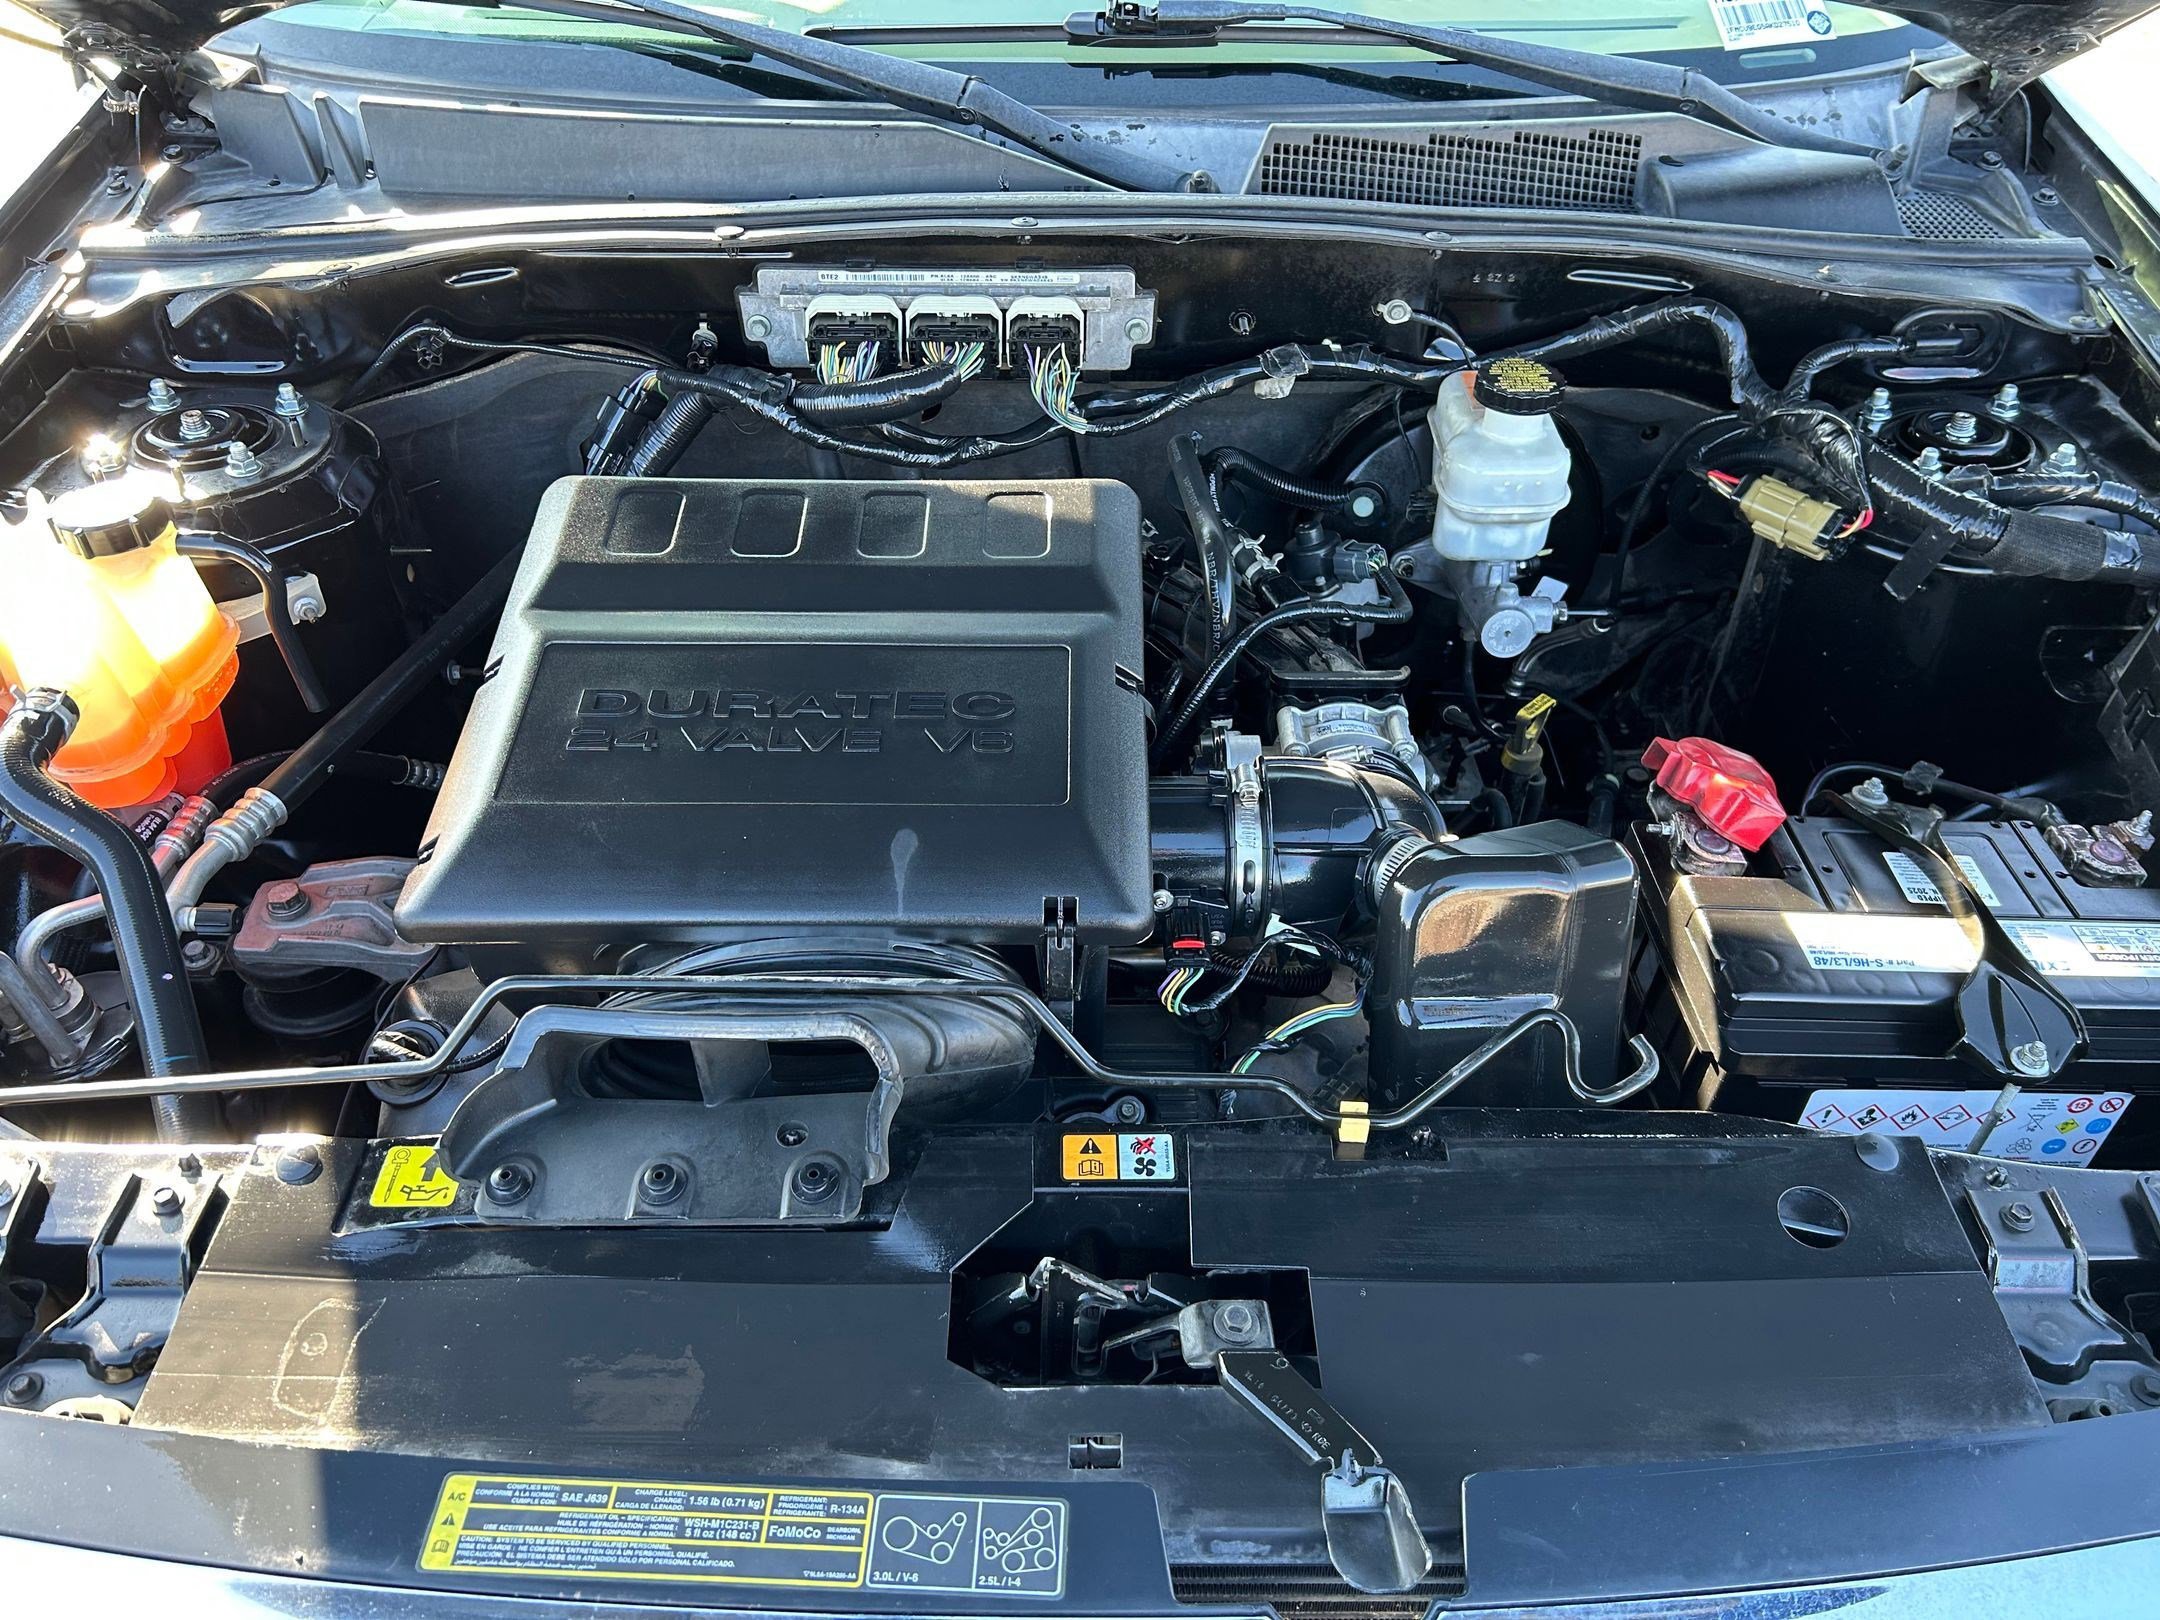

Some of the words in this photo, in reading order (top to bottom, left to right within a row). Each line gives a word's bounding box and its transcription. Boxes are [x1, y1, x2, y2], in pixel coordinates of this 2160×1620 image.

[576, 688, 1016, 720] DURATEC
[565, 726, 659, 752] 24
[680, 726, 883, 753] VALVE
[923, 727, 1015, 754] V6
[1917, 894, 1942, 902] IPPED
[1813, 956, 1884, 968] S-H6/L3/48
[1895, 959, 1915, 967] Part
[475, 1488, 513, 1497] CONFORME
[530, 1490, 555, 1498] NORME
[507, 1483, 541, 1491] COMPLIES
[635, 1488, 664, 1497] CHARGE
[448, 1492, 467, 1501] A/C
[511, 1497, 539, 1505] CUMPLE
[561, 1492, 583, 1503] SAE
[584, 1493, 609, 1504] J639
[654, 1496, 683, 1504] CHARGE
[779, 1495, 828, 1504] REFRIGERANT:
[651, 1503, 685, 1511] LLENADO:
[689, 1496, 709, 1506] 1.56
[710, 1497, 720, 1506] lb
[721, 1497, 746, 1508] (0.71
[748, 1498, 766, 1510] kg)
[773, 1508, 826, 1517] REFRIGERANTE:
[830, 1504, 865, 1515] R-134A
[557, 1519, 578, 1527] HUILE
[559, 1511, 607, 1520] REFRIGERANT
[608, 1513, 619, 1521] OIL
[627, 1515, 680, 1523] SPECIFICATION:
[684, 1518, 760, 1530] WSH-M1C231-B
[483, 1523, 498, 1531] USE
[498, 1524, 524, 1532] ACEITE
[525, 1525, 544, 1533] PARA
[544, 1526, 601, 1535] REFRIGERANTES
[602, 1527, 641, 1536] CONFORME
[648, 1530, 676, 1538] NORMA:
[684, 1528, 692, 1537] 5
[693, 1528, 701, 1537] fl
[702, 1530, 715, 1538] oz
[716, 1529, 738, 1540] (148
[739, 1530, 757, 1540] cc)
[769, 1525, 822, 1539] FoMoCo
[496, 1536, 525, 1544] SYSTEM
[546, 1538, 581, 1546] SERVICED
[592, 1540, 628, 1549] QUALIFIED
[629, 1542, 672, 1550] PERSONNEL.
[529, 1545, 560, 1553] CONFIER
[560, 1546, 604, 1555] L'ENTRETIEN
[634, 1550, 675, 1558] PERSONNEL
[516, 1552, 546, 1560] SISTEMA
[547, 1553, 567, 1561] DEBE
[582, 1555, 618, 1563] ATENDIDO
[618, 1556, 638, 1564] SOLO
[638, 1557, 654, 1565] POR
[654, 1558, 691, 1566] PERSONAL
[692, 1560, 735, 1568] CALIFICADO.
[873, 1571, 895, 1582] 3.0L
[902, 1572, 919, 1583] V-6
[978, 1575, 1000, 1587] 2.5L
[1007, 1577, 1022, 1588] I-4
